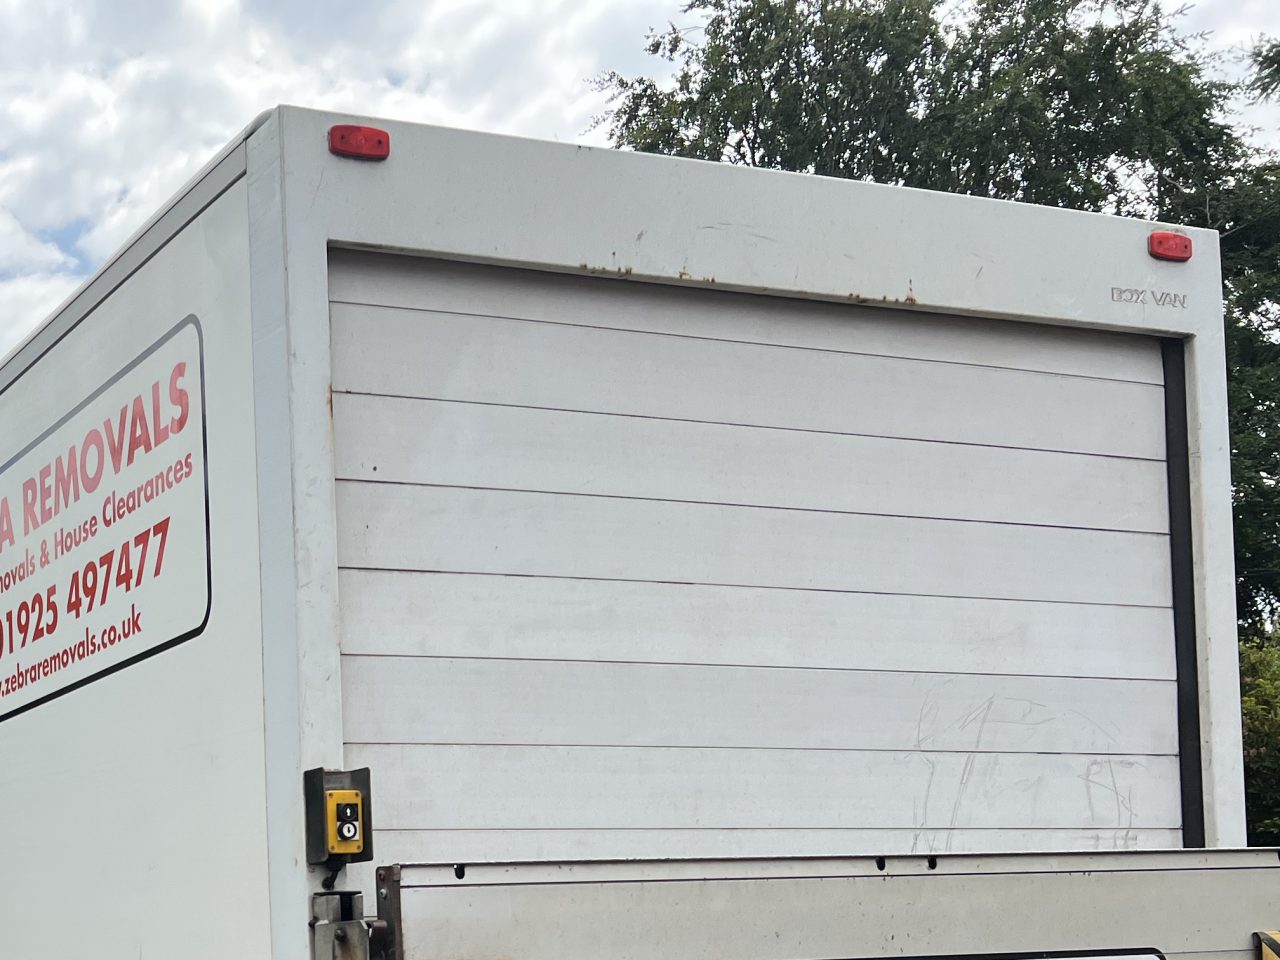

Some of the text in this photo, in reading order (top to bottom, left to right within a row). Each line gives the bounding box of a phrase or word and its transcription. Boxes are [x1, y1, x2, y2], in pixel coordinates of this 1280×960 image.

[1111, 287, 1188, 309] BOX VAN
[22, 362, 190, 537] REMOVALS
[39, 538, 51, 568] &
[53, 515, 98, 559] House
[102, 452, 193, 528] Clearances
[66, 516, 171, 619] 497477
